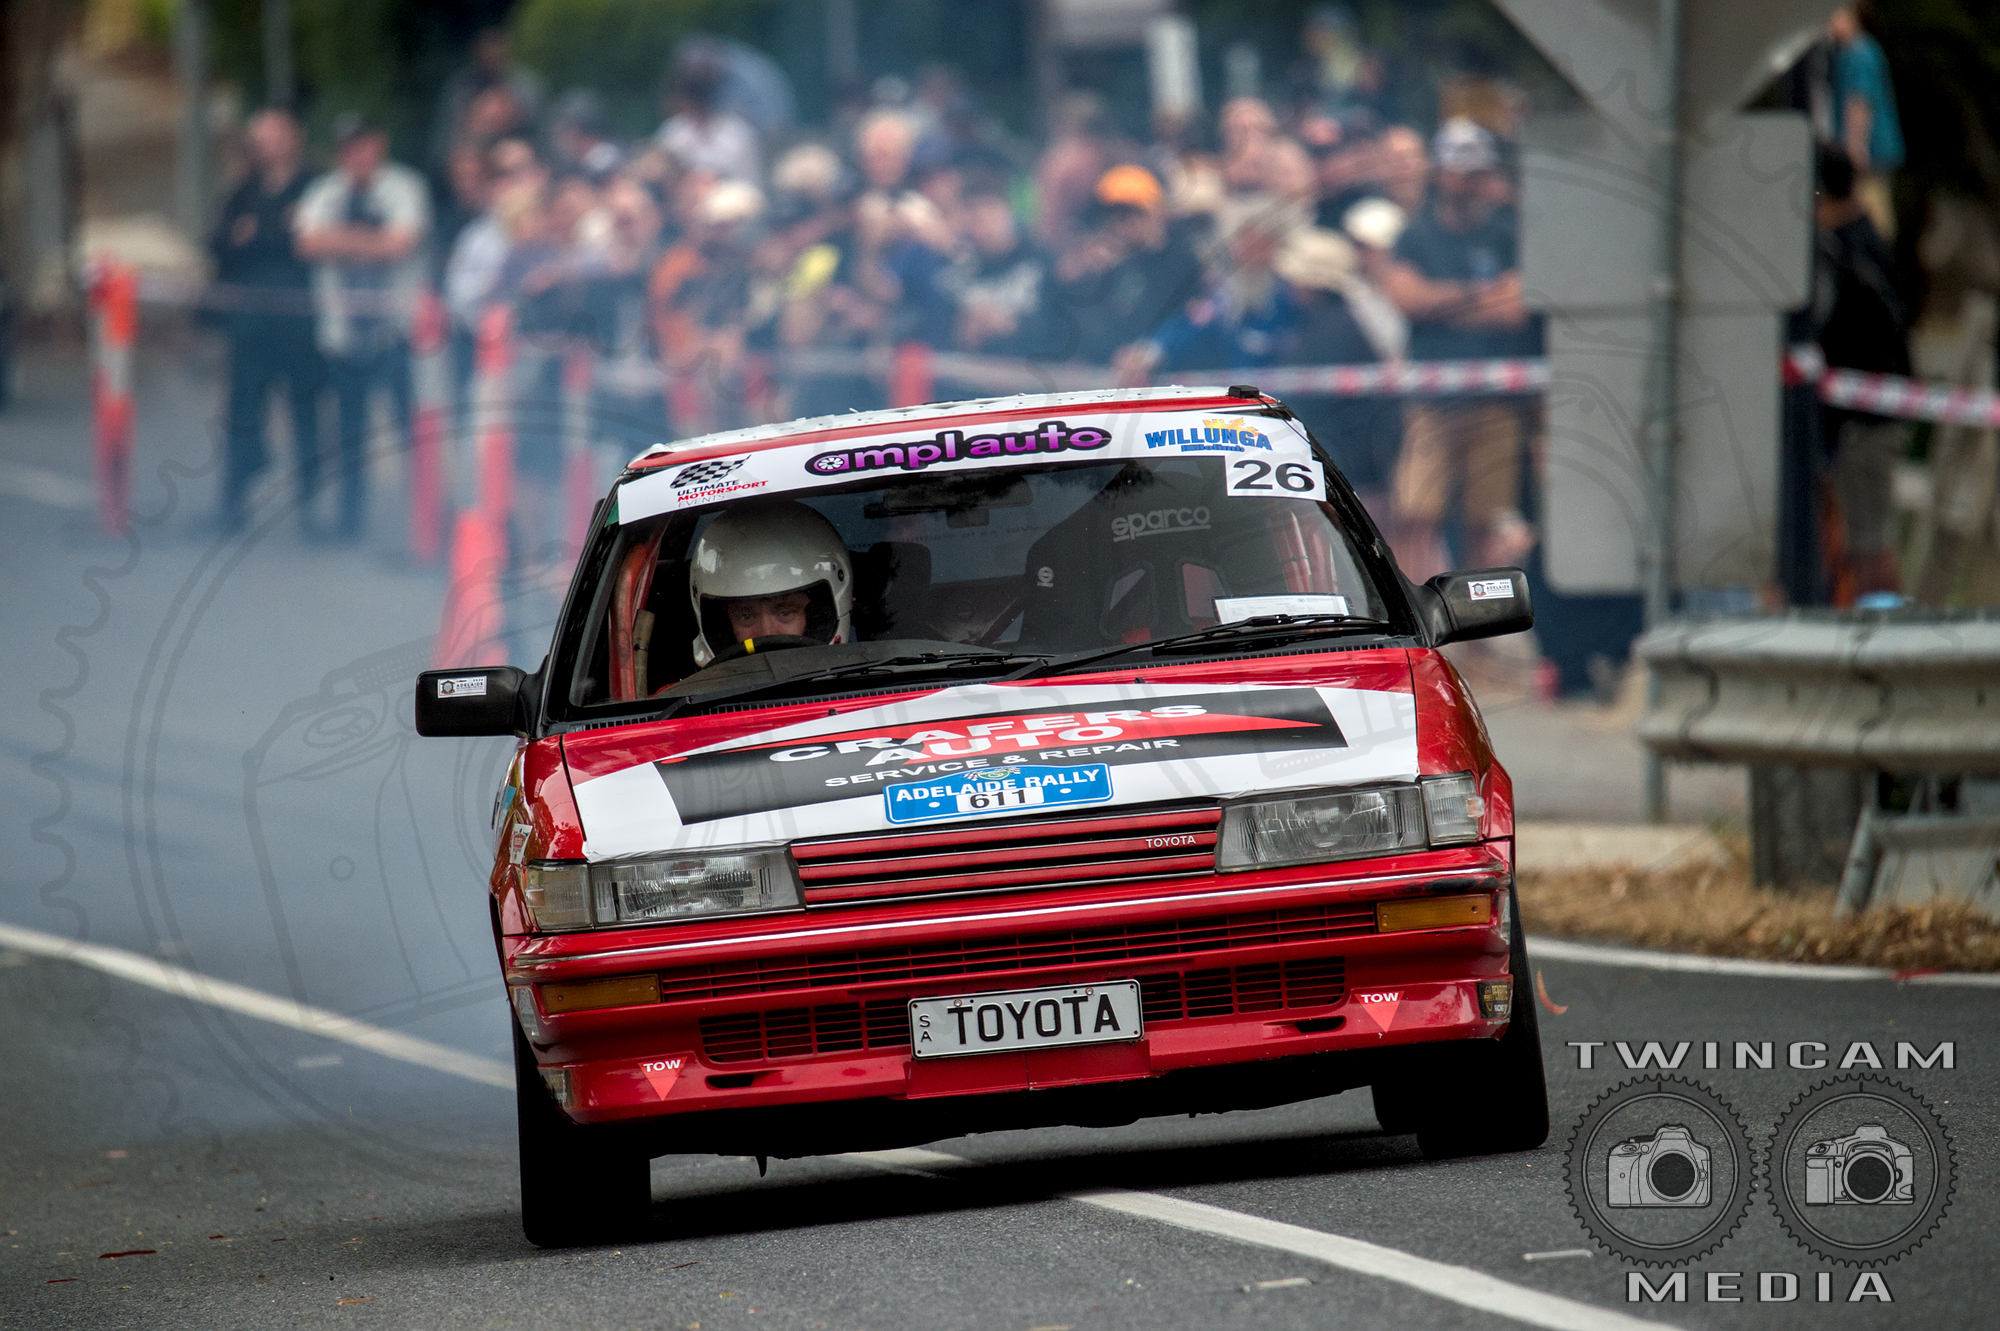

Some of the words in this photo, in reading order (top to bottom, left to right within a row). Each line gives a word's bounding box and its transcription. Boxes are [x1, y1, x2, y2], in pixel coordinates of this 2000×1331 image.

[1144, 427, 1274, 452] WILLUNGA
[676, 479, 740, 497] ULTIMATE
[1232, 459, 1316, 493] 26
[677, 480, 769, 503] MOTORSPORT
[678, 494, 726, 508] EVENTS
[1110, 505, 1211, 540] sparco
[769, 704, 1208, 762] CRAFERS
[865, 725, 1124, 767] AUTO
[824, 758, 991, 787] SERVICE
[1001, 754, 1029, 765] &
[1039, 738, 1181, 761] REPAIR
[896, 778, 1017, 802] ADELAIDE
[1025, 768, 1100, 788] RALLY
[970, 788, 1028, 809] 611
[1145, 835, 1196, 849] TOYOTA
[1360, 992, 1399, 1004] TOW
[947, 992, 1121, 1045] TOYOTA
[643, 1058, 681, 1073] TOW
